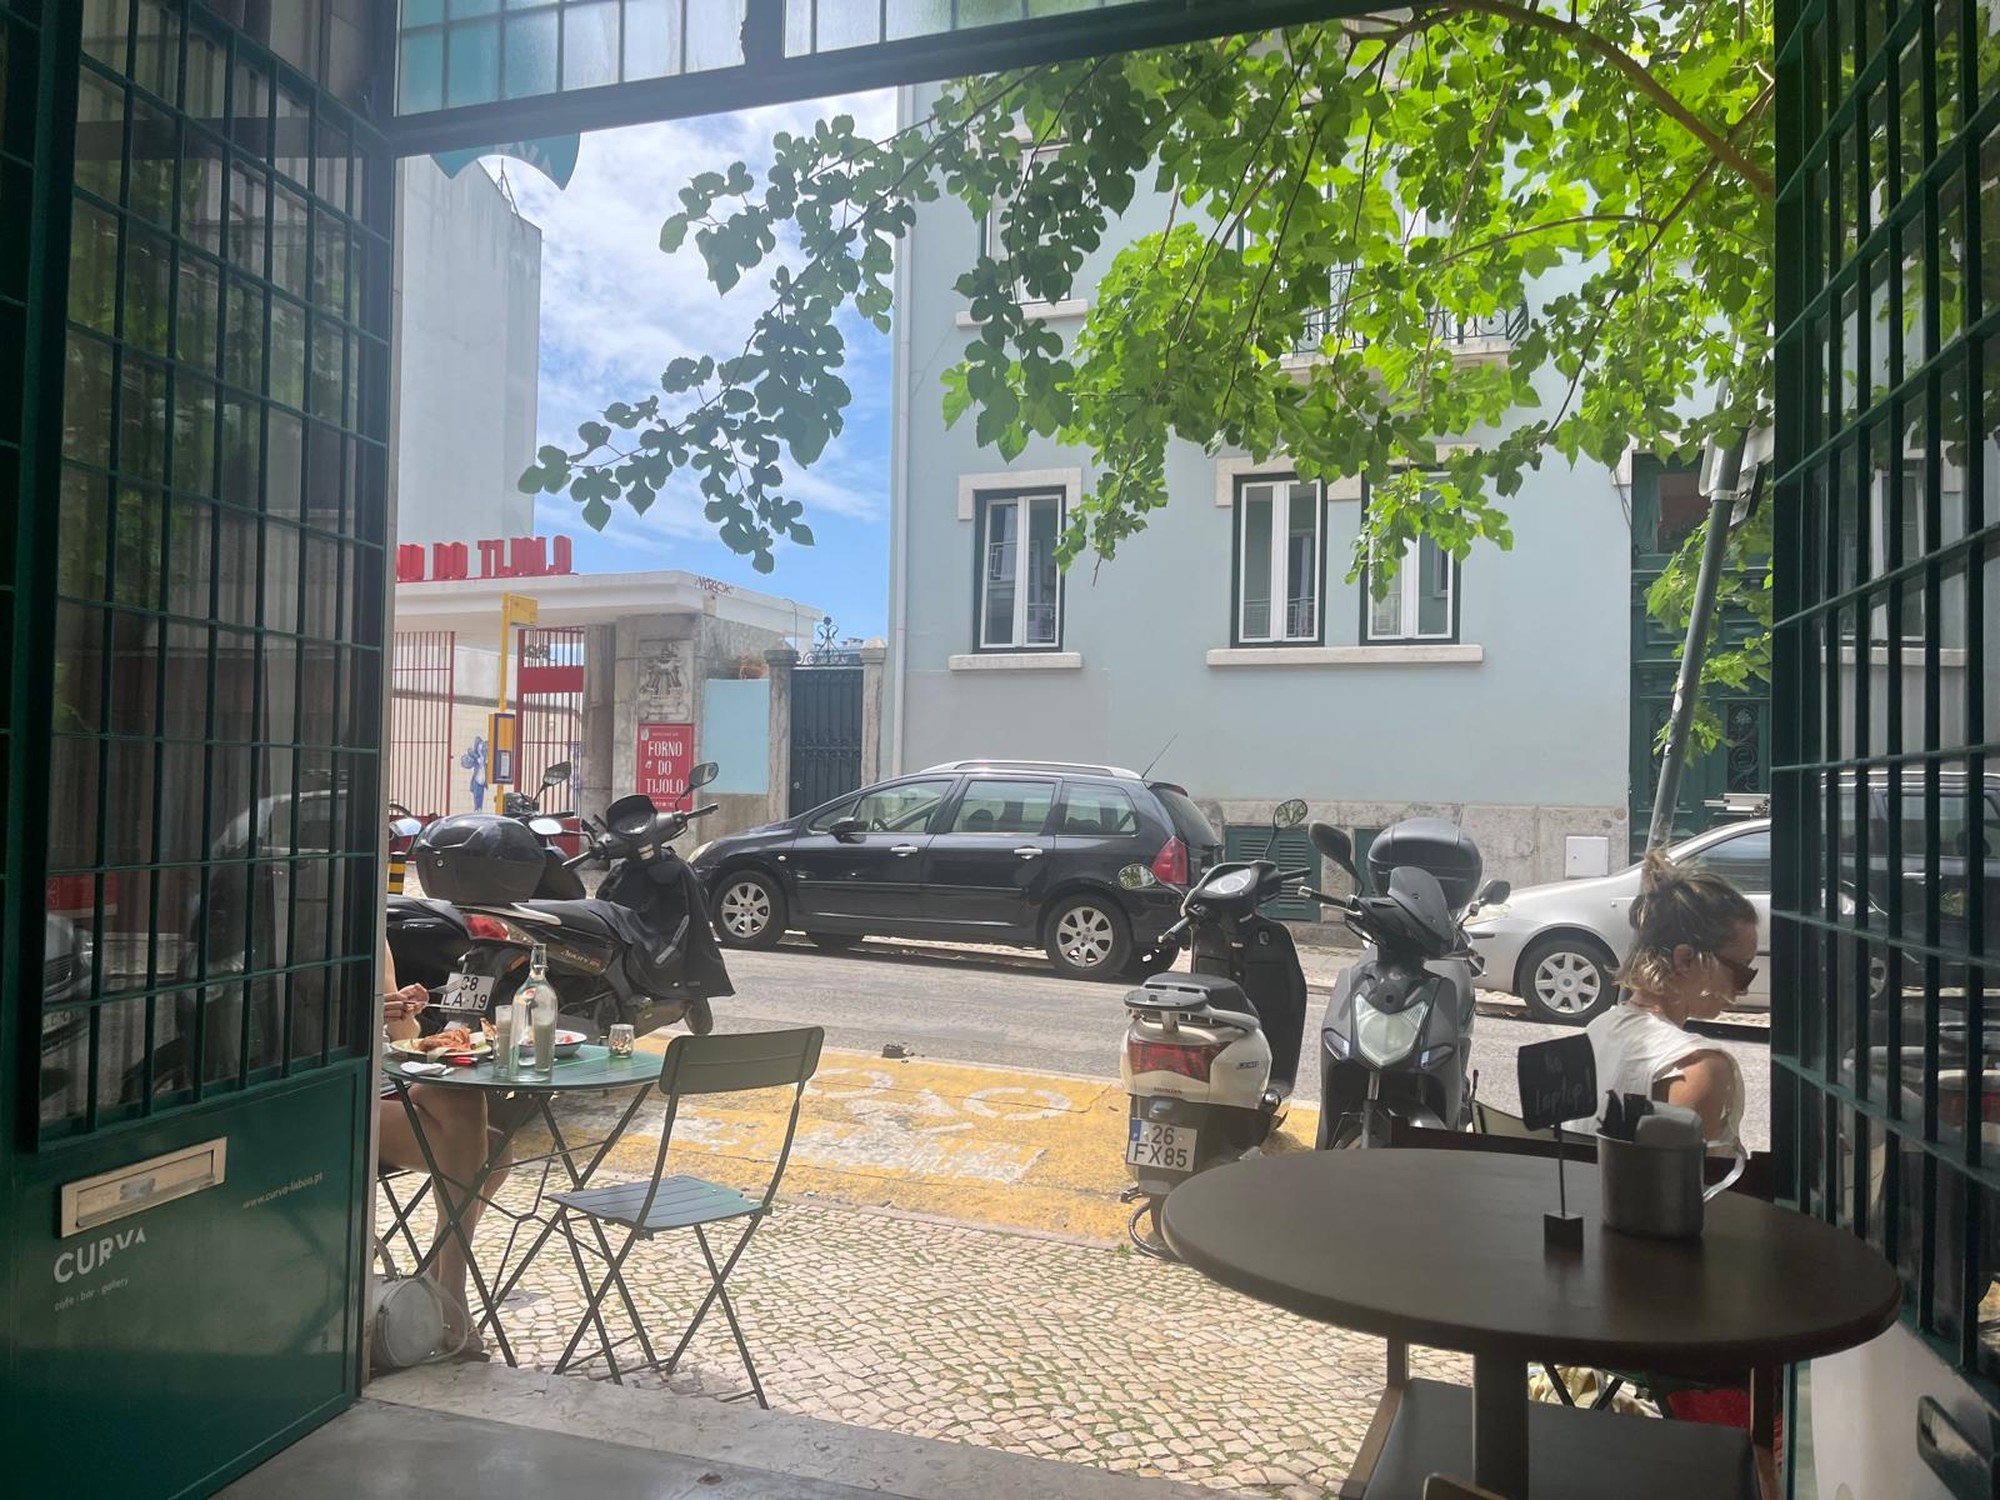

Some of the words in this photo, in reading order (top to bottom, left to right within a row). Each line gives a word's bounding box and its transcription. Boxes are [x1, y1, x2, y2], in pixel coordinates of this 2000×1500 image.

[648, 740, 682, 757] FORNO
[657, 760, 672, 776] DO
[645, 778, 684, 794] TIJOLO
[1151, 1124, 1175, 1146] 26
[1133, 1142, 1188, 1168] FX85
[53, 1227, 147, 1284] CURVA
